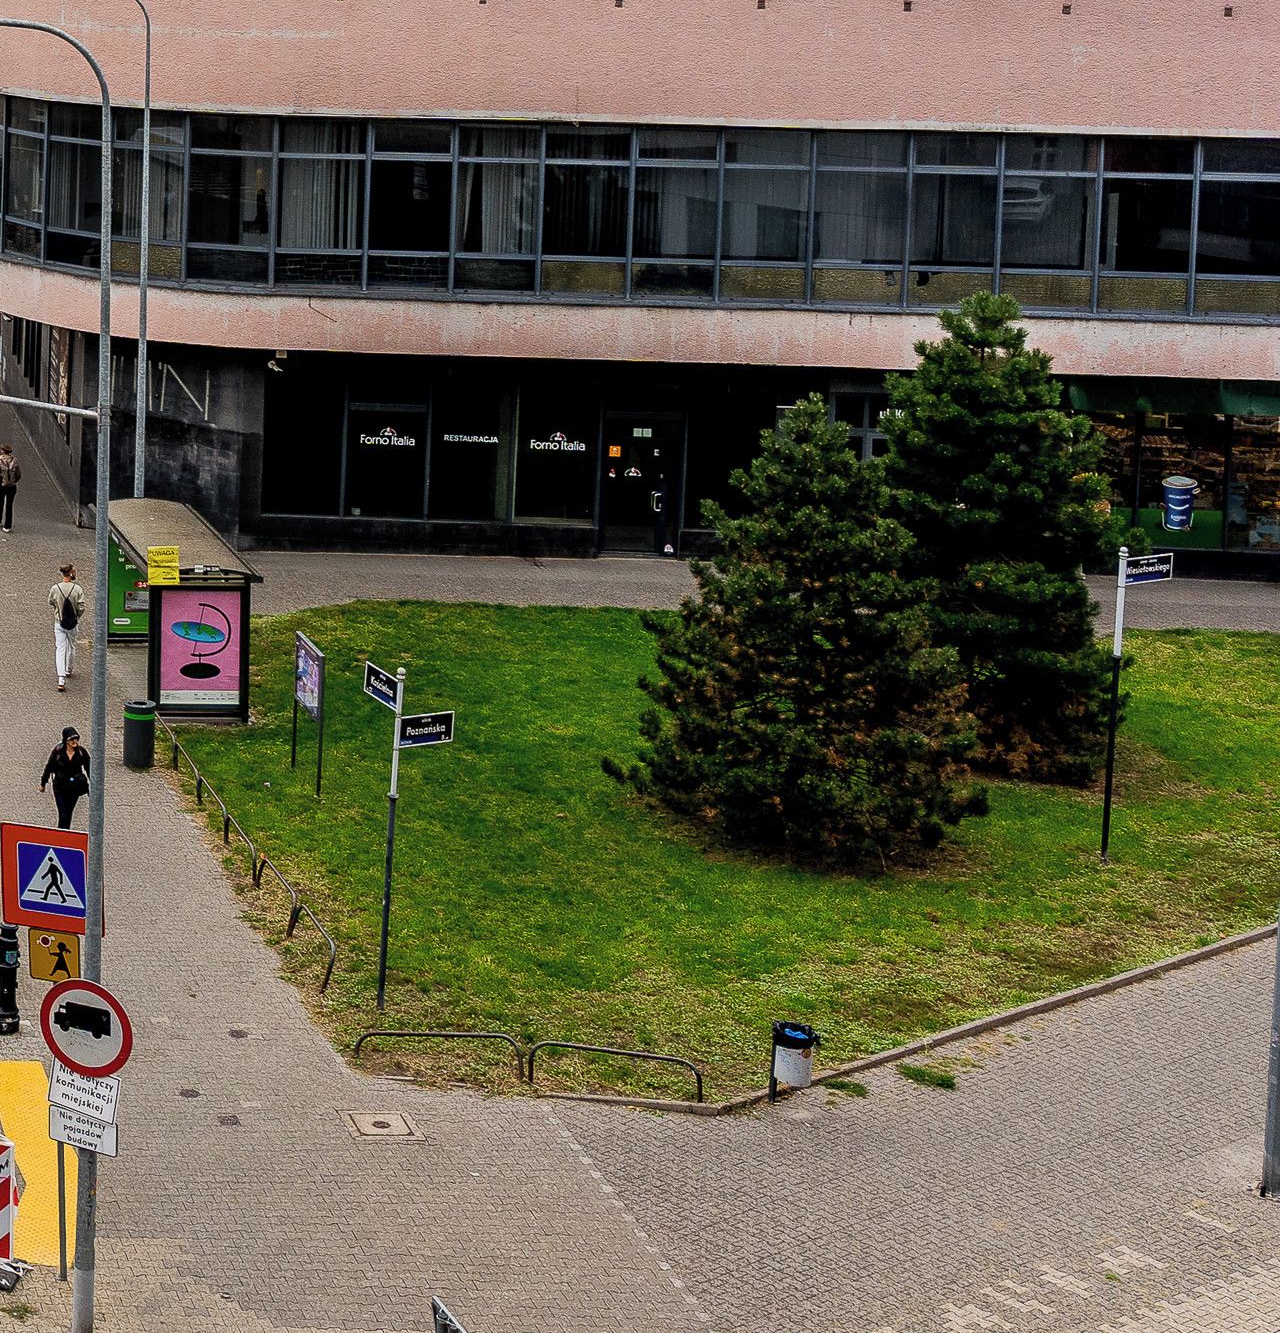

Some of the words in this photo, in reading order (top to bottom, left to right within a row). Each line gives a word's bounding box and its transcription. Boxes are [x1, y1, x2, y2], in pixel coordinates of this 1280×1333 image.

[359, 434, 389, 445] Forno
[391, 435, 416, 446] Italia
[443, 434, 499, 444] RESTAURACJA
[530, 439, 559, 450] Forno
[560, 440, 586, 451] Italia
[406, 724, 446, 736] Poznańska
[59, 1063, 75, 1077] Nie
[55, 1074, 114, 1105] komunikacji
[61, 1091, 104, 1115] miejskiej
[59, 1110, 73, 1122] Nie
[75, 1115, 107, 1132] dotyczy
[66, 1133, 98, 1150] budowy
